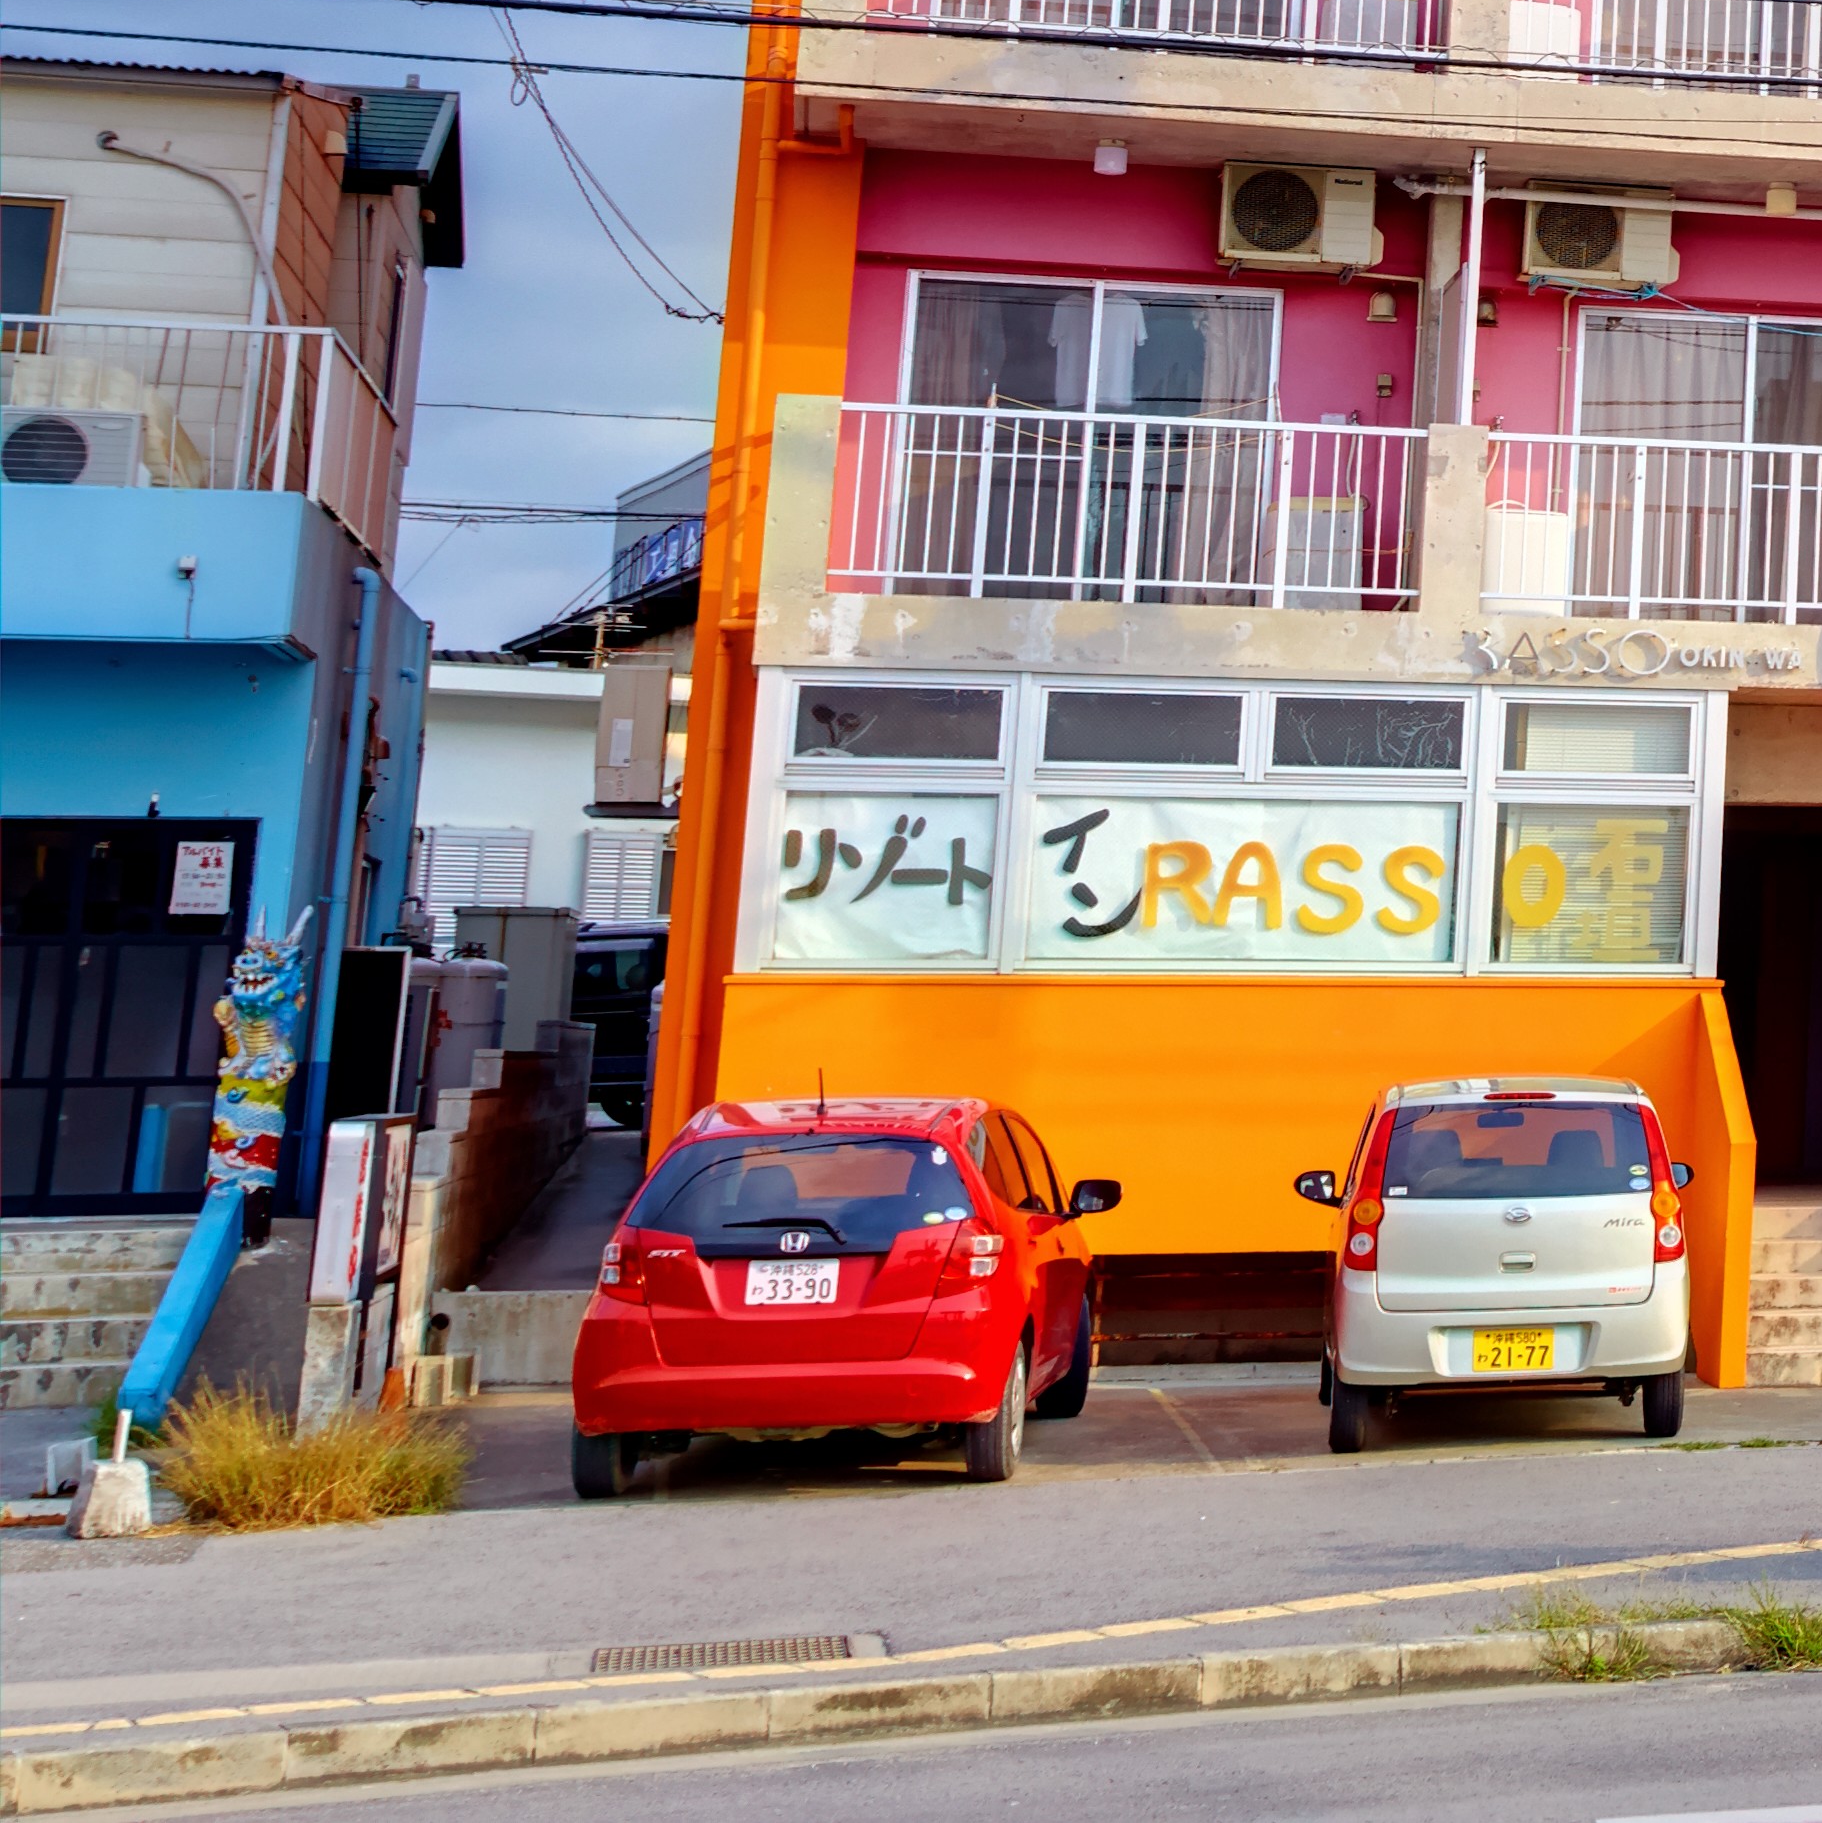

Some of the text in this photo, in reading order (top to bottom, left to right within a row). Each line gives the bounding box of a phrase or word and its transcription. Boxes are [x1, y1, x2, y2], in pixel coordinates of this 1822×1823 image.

[1334, 178, 1363, 187] National
[1679, 645, 1803, 670] OKINWA
[784, 813, 993, 906] リゾート
[1141, 839, 1567, 935] RASSO
[1573, 818, 1669, 962] 石垣
[1603, 1217, 1645, 1228] Mira
[766, 1278, 832, 1301] 33-90
[1490, 1345, 1549, 1368] 21-77
